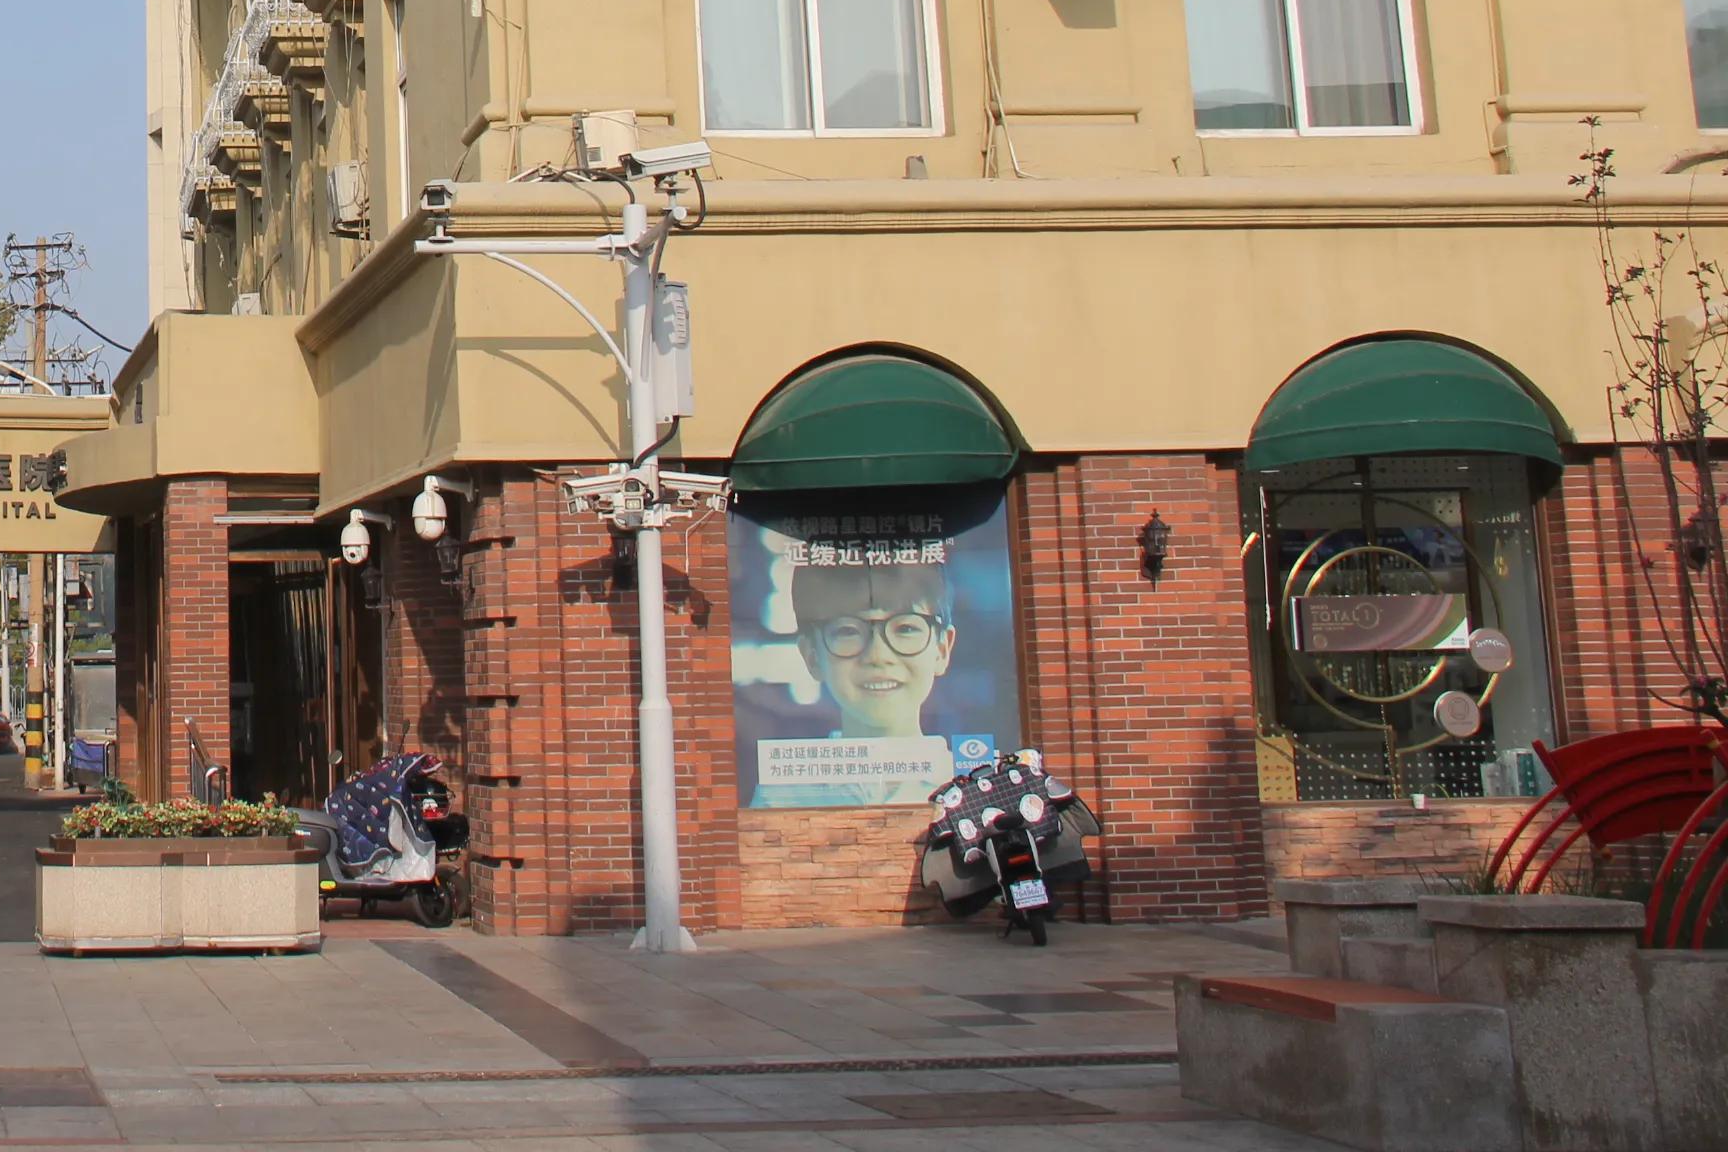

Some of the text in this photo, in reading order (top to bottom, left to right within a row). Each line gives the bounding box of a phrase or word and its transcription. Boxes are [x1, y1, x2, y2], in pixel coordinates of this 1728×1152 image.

[783, 538, 945, 567] 延缓近视进展
